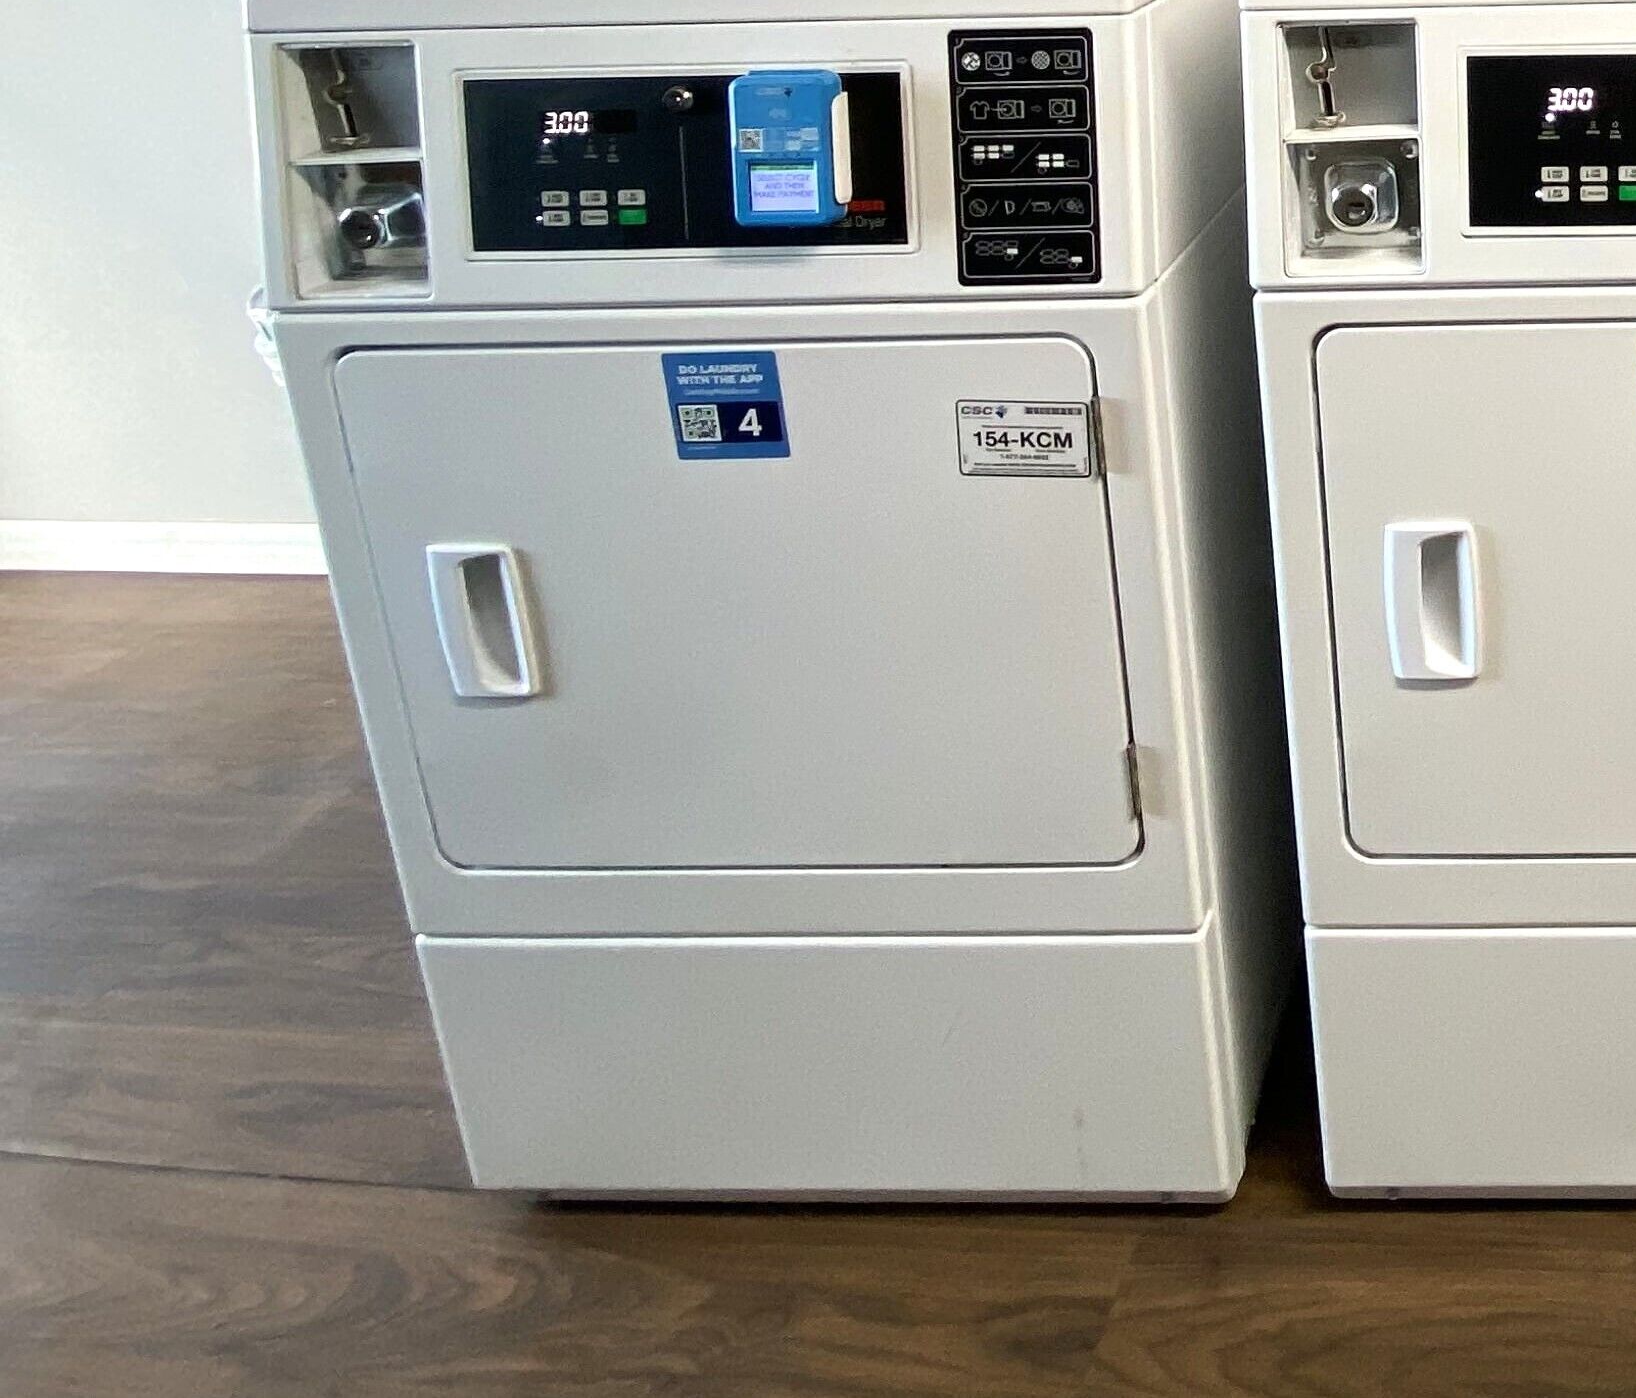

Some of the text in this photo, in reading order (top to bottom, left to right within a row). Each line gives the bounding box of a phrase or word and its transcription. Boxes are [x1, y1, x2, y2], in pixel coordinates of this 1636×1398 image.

[1547, 87, 1594, 111] 3.00
[544, 110, 589, 134] 3.00
[855, 215, 886, 230] Dryer
[679, 364, 757, 374] DO LAUNDRY
[677, 374, 763, 385] WITH THE APP
[961, 405, 993, 415] CSC
[738, 408, 762, 436] 4
[973, 431, 1073, 449] 154-KCM
